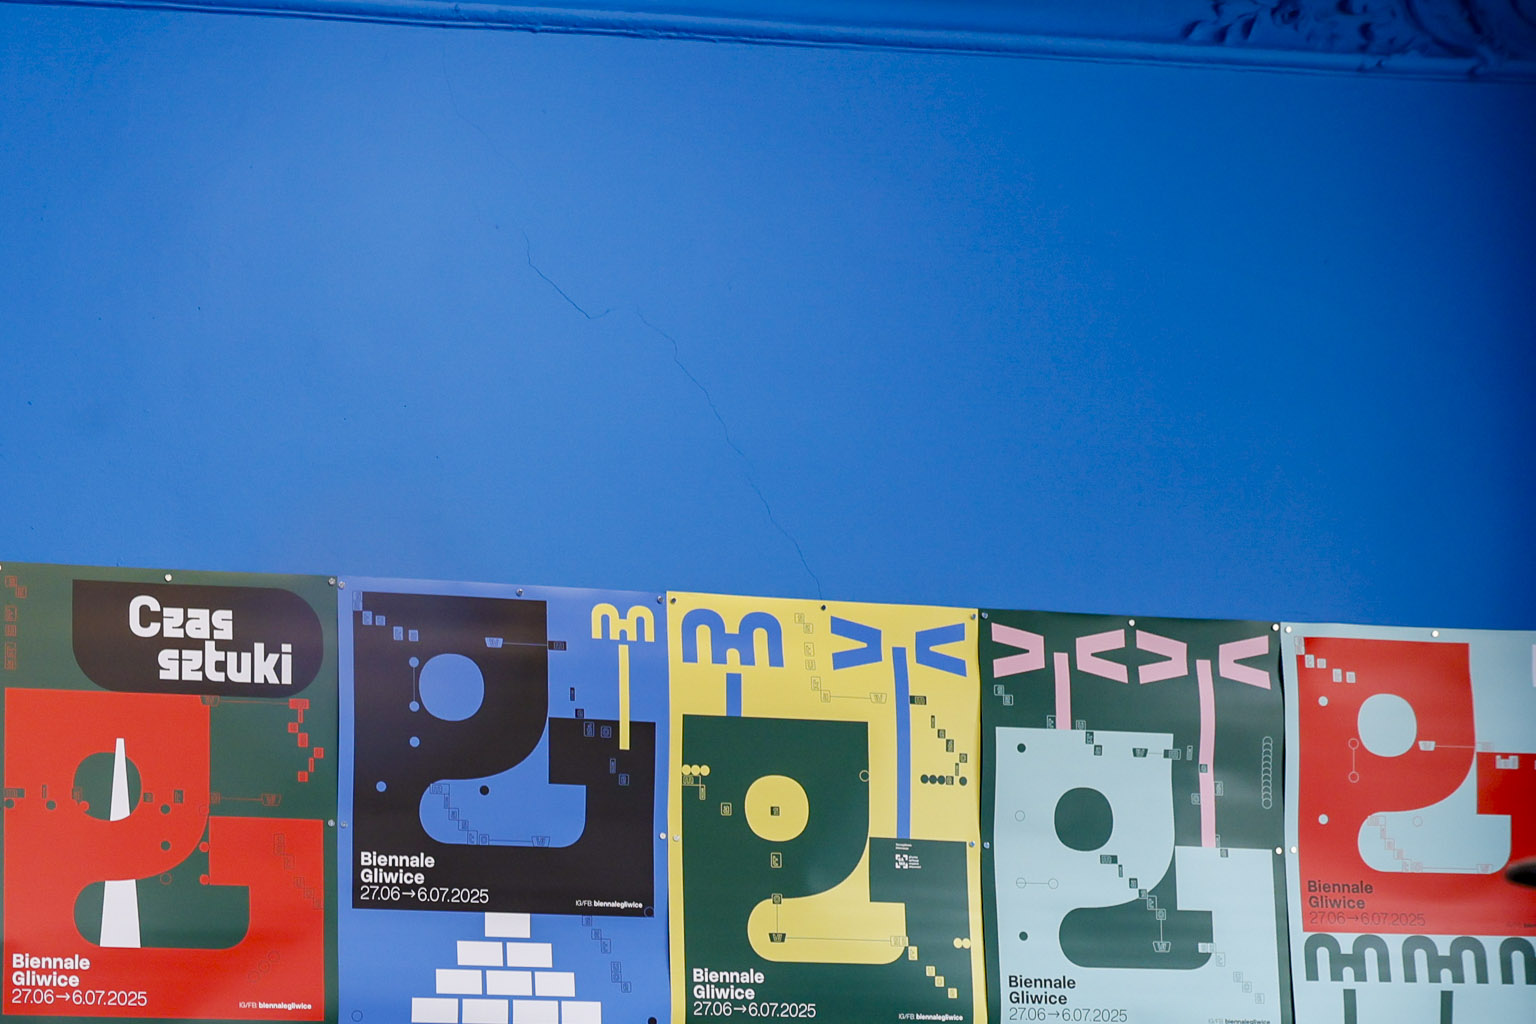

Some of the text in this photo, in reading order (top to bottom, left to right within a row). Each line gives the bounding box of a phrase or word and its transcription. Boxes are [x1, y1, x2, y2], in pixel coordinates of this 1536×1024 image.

[129, 595, 233, 640] Czas
[157, 640, 292, 685] sztuki
[360, 851, 435, 867] Biennale
[360, 868, 425, 884] Gliwice
[1307, 880, 1373, 894] Biennale
[593, 900, 643, 909] biennalegliwice
[1308, 895, 1366, 909] Gliwice
[12, 953, 90, 970] Biennale
[12, 970, 80, 987] Gliwice
[692, 968, 765, 984] Biennale
[1008, 975, 1076, 990] Biennale
[693, 984, 755, 1000] Gliwice
[1009, 991, 1068, 1005] Gliwice
[258, 1002, 312, 1011] biennalegliwice
[916, 1013, 963, 1022] biennalegliwice
